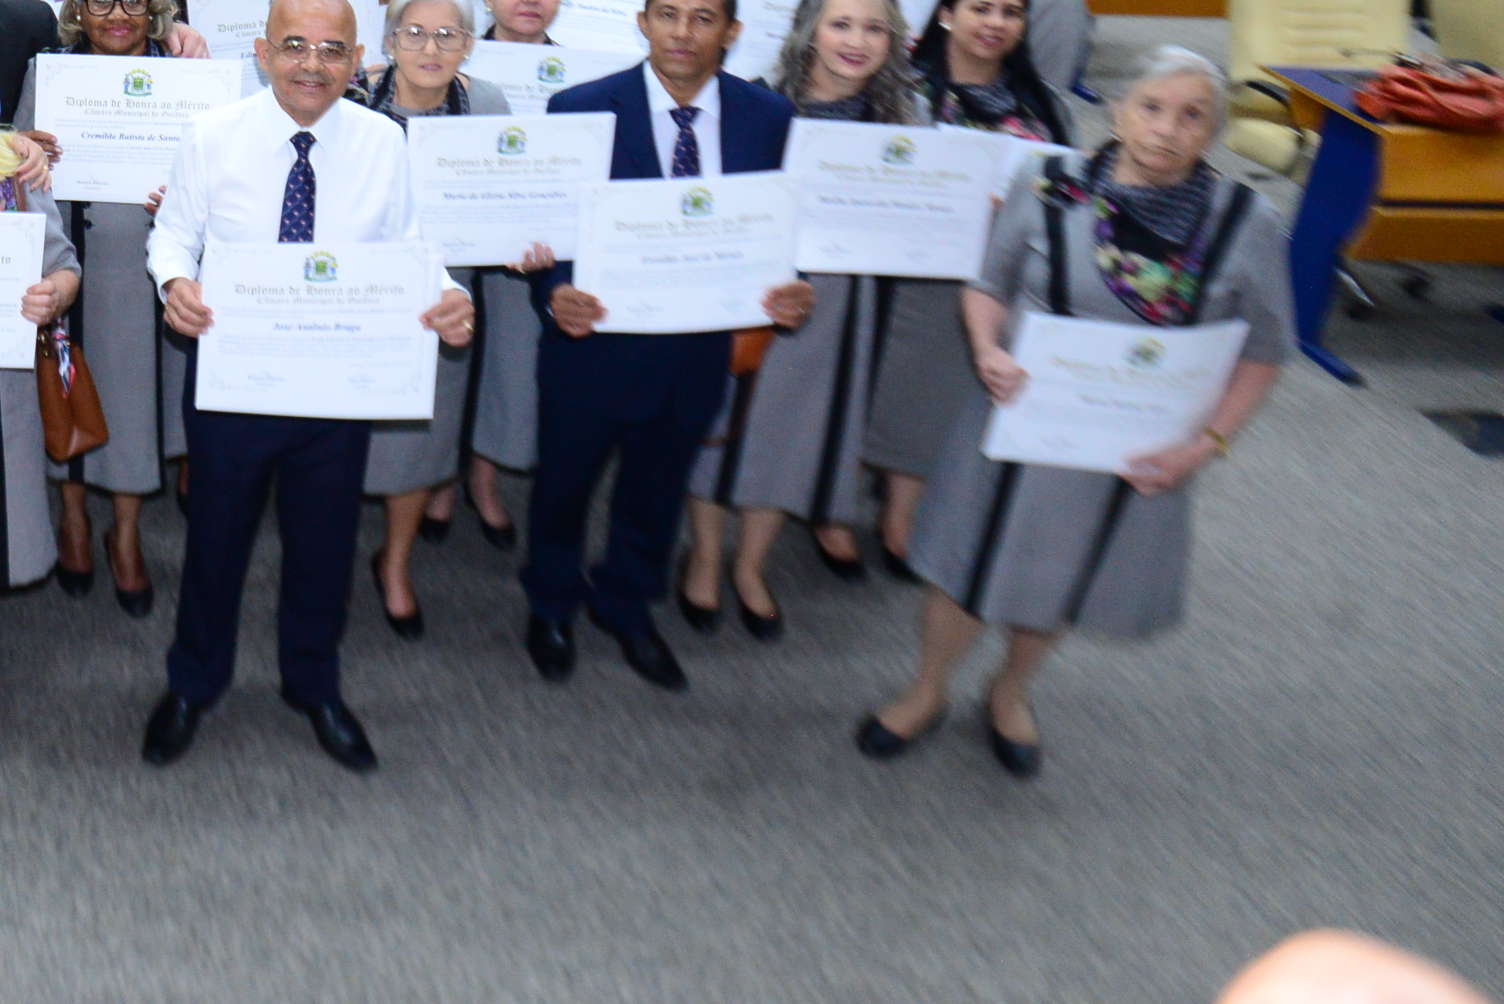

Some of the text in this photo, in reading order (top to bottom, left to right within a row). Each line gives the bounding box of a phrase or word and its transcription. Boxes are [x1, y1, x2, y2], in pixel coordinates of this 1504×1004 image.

[216, 21, 257, 33] Diploma
[65, 96, 210, 111] Diploma de Honra ao Mérito
[81, 131, 117, 141] Cremilda
[118, 132, 145, 141] Batista
[147, 133, 156, 141] de
[234, 284, 405, 296] Diploma de Honra ao Mérito
[272, 322, 293, 331] José
